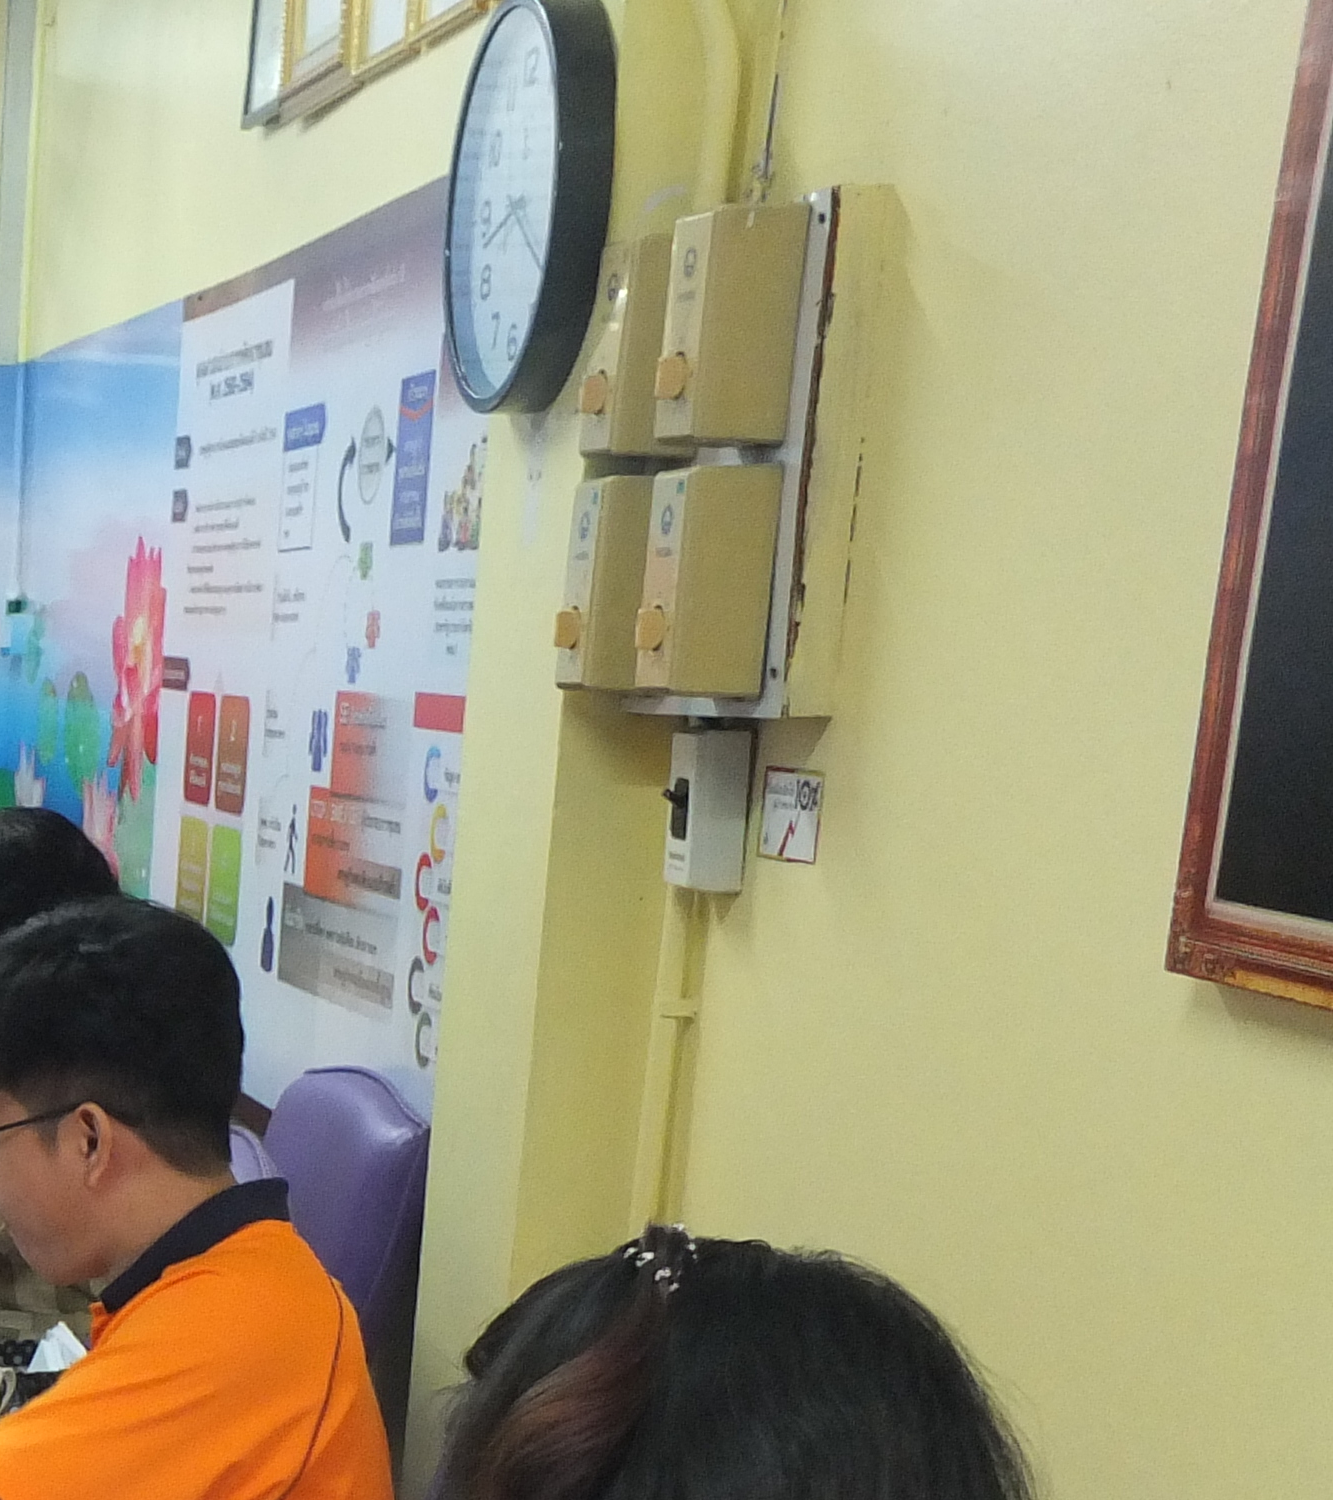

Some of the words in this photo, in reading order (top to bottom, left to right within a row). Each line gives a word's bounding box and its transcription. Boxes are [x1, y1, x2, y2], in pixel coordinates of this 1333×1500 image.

[479, 264, 491, 300] 8
[491, 311, 500, 350] 7
[506, 323, 517, 361] 6
